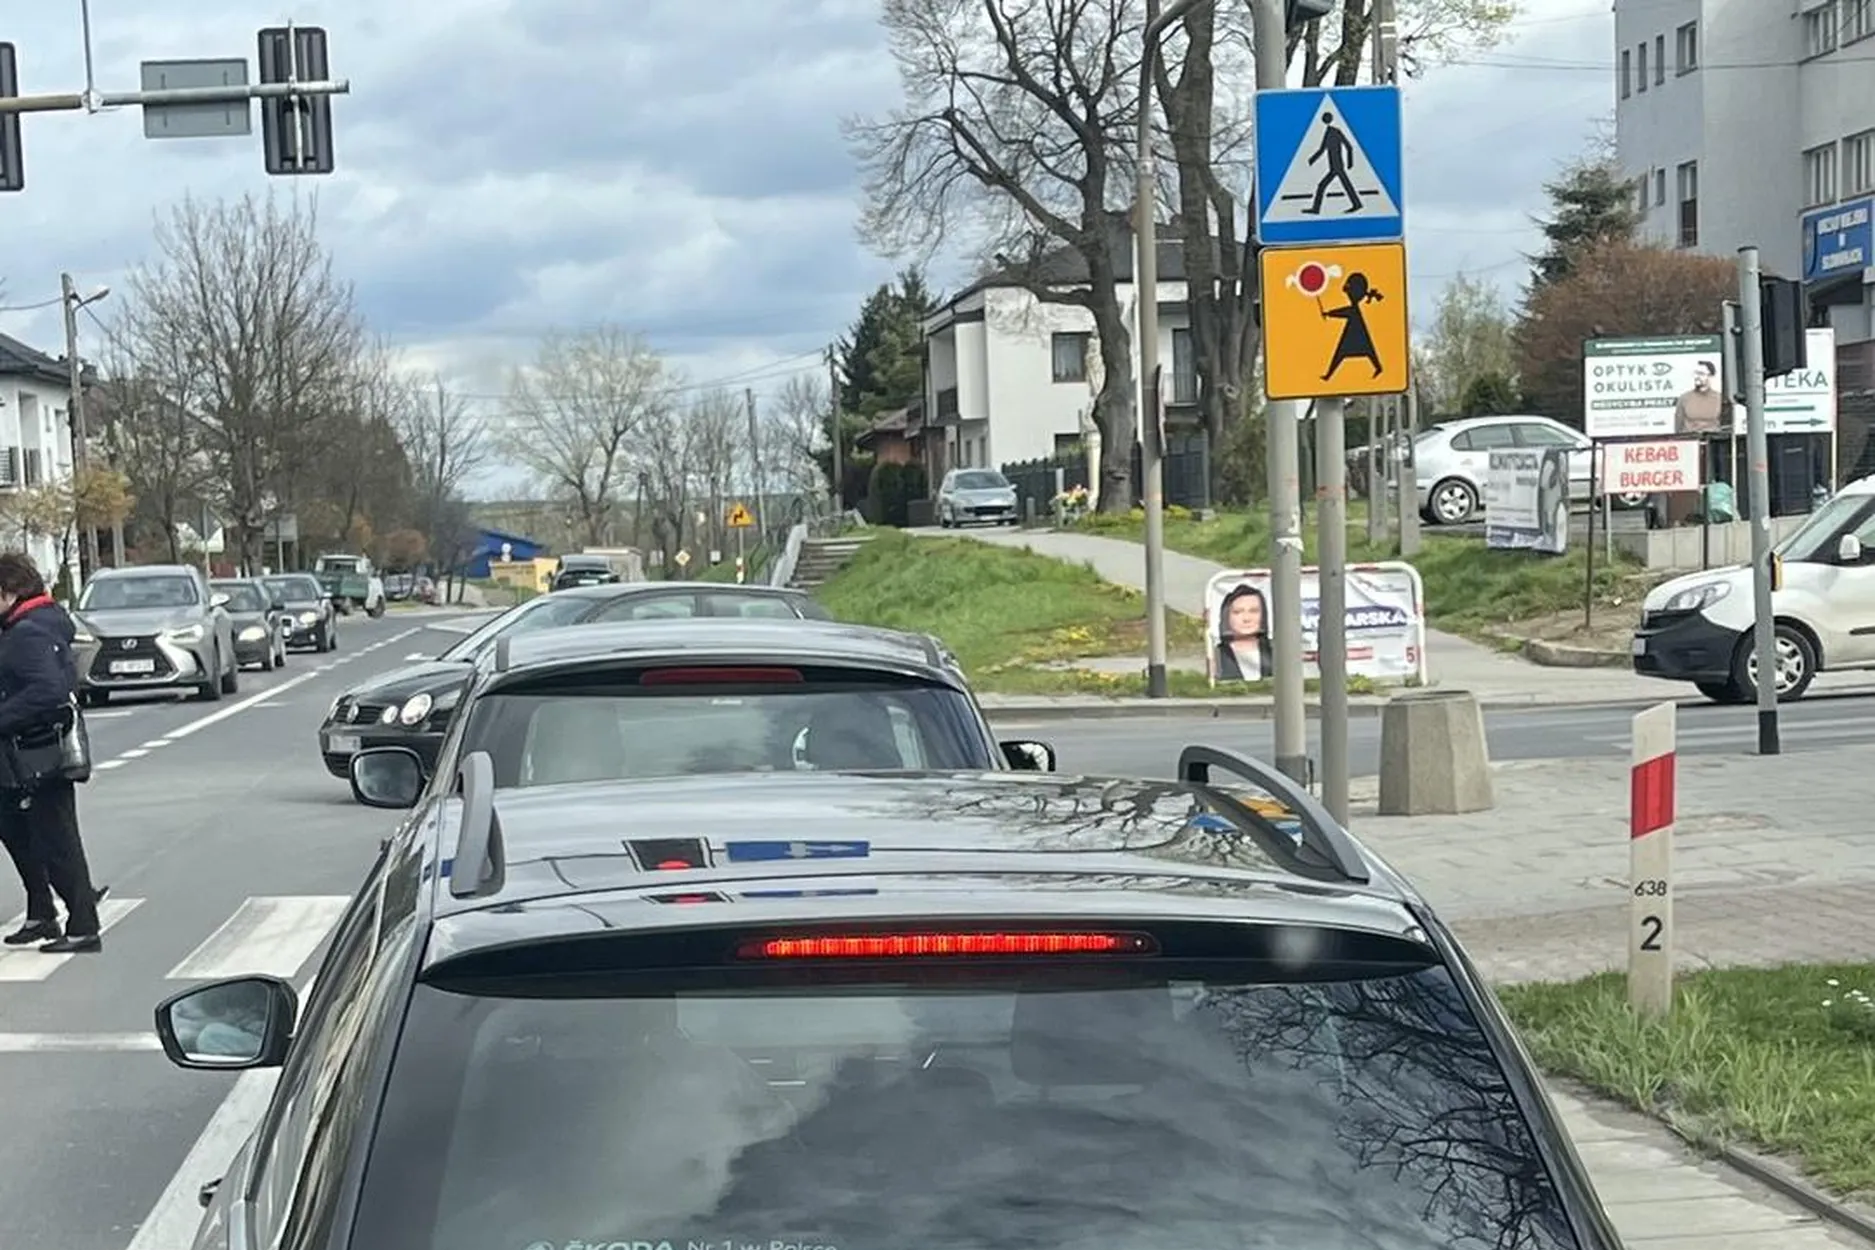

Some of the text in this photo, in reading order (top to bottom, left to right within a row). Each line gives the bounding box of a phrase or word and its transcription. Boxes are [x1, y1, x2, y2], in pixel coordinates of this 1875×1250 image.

[1593, 363, 1647, 377] OPTYK
[1594, 380, 1674, 393] OKULISTA
[1624, 446, 1680, 463] KEBAB
[1619, 470, 1684, 488] BURGER
[1405, 646, 1416, 664] 5
[1634, 880, 1668, 897] 638
[1640, 916, 1663, 951] 2
